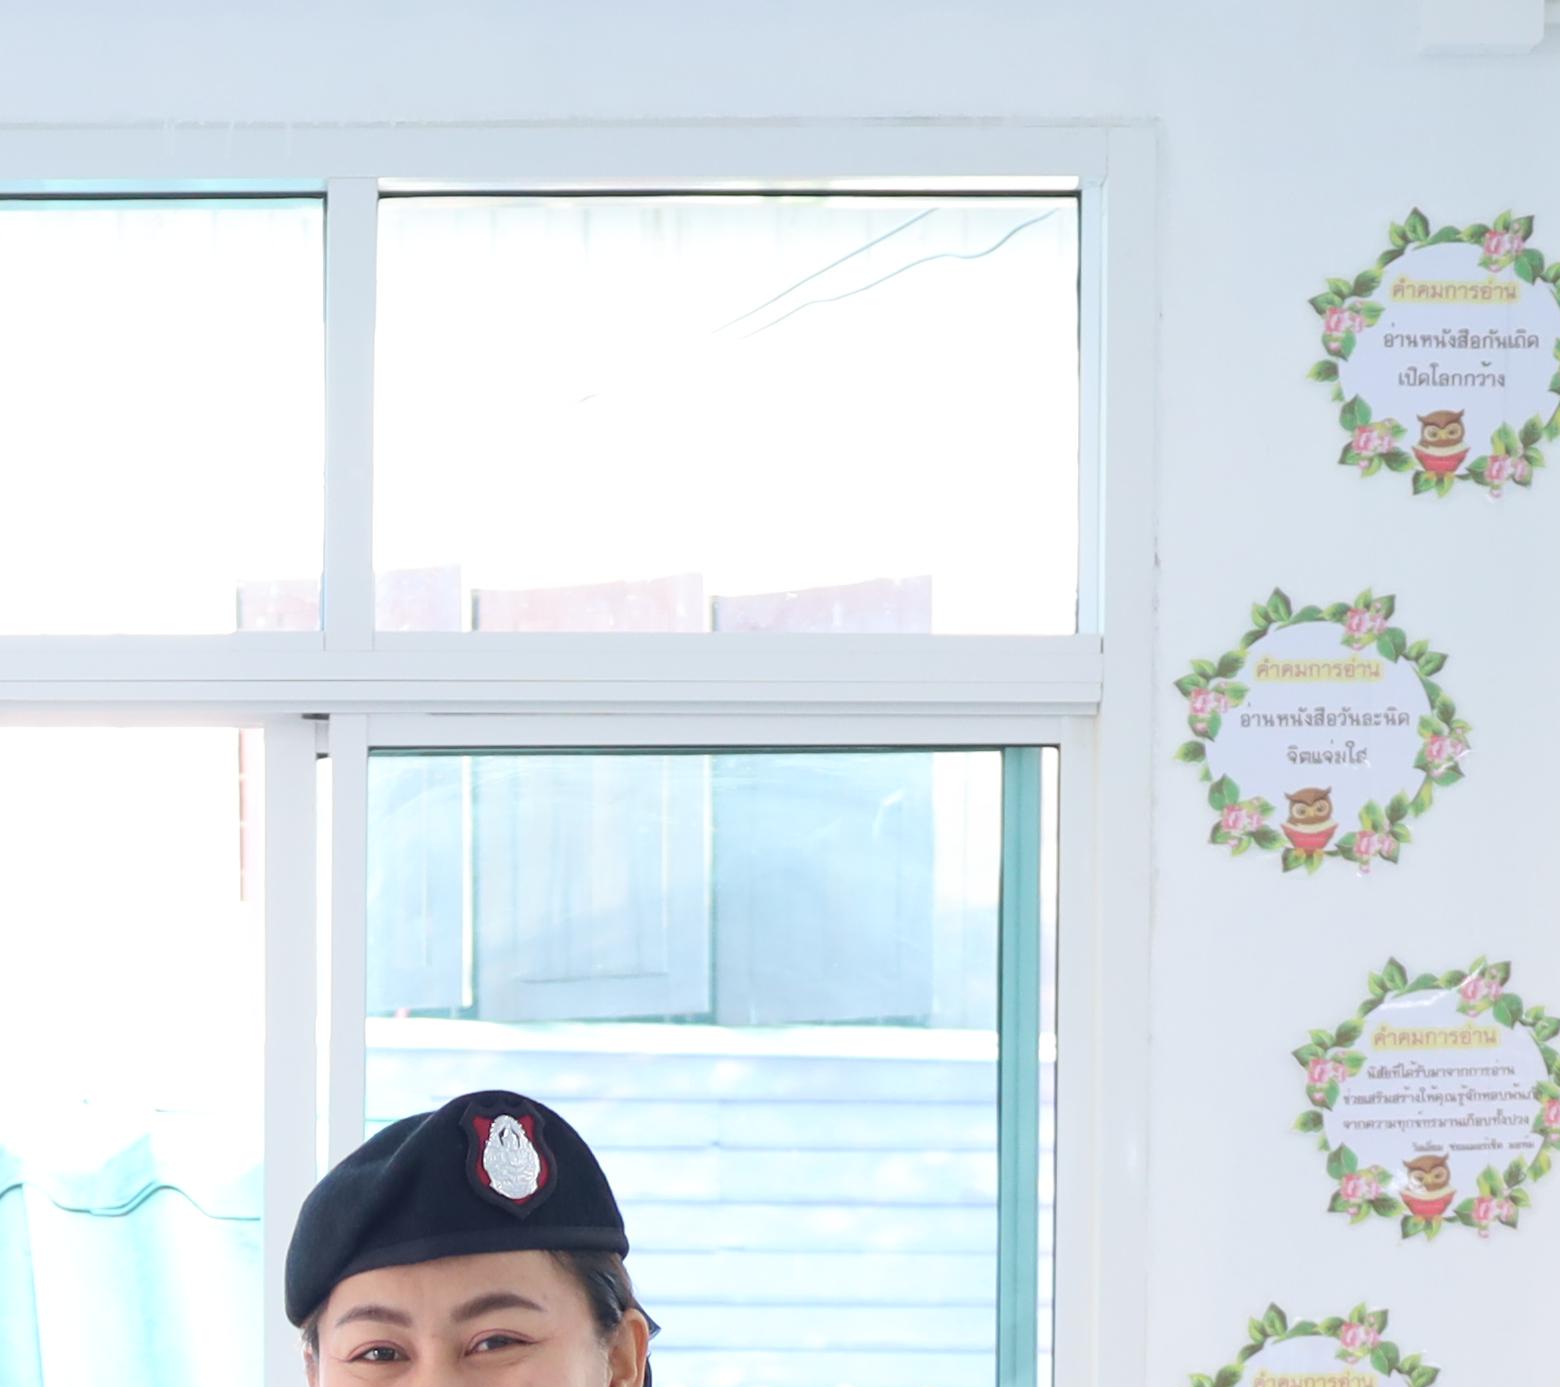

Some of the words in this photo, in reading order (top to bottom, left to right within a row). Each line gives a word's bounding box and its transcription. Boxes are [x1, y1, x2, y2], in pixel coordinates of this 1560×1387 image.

[1393, 278, 1516, 299] คำคมการอ่าน
[1383, 323, 1539, 349] อ่านหนังสือกันเถิด
[1398, 361, 1505, 387] เปิดโลกกว้าง
[1257, 657, 1380, 678] คำคมการอ่าน
[1240, 703, 1410, 728] อ่านหนังสือวันละนิด
[1287, 740, 1367, 764] จิตแจ่มใส
[1375, 1026, 1496, 1047] คำคมการอ่าน
